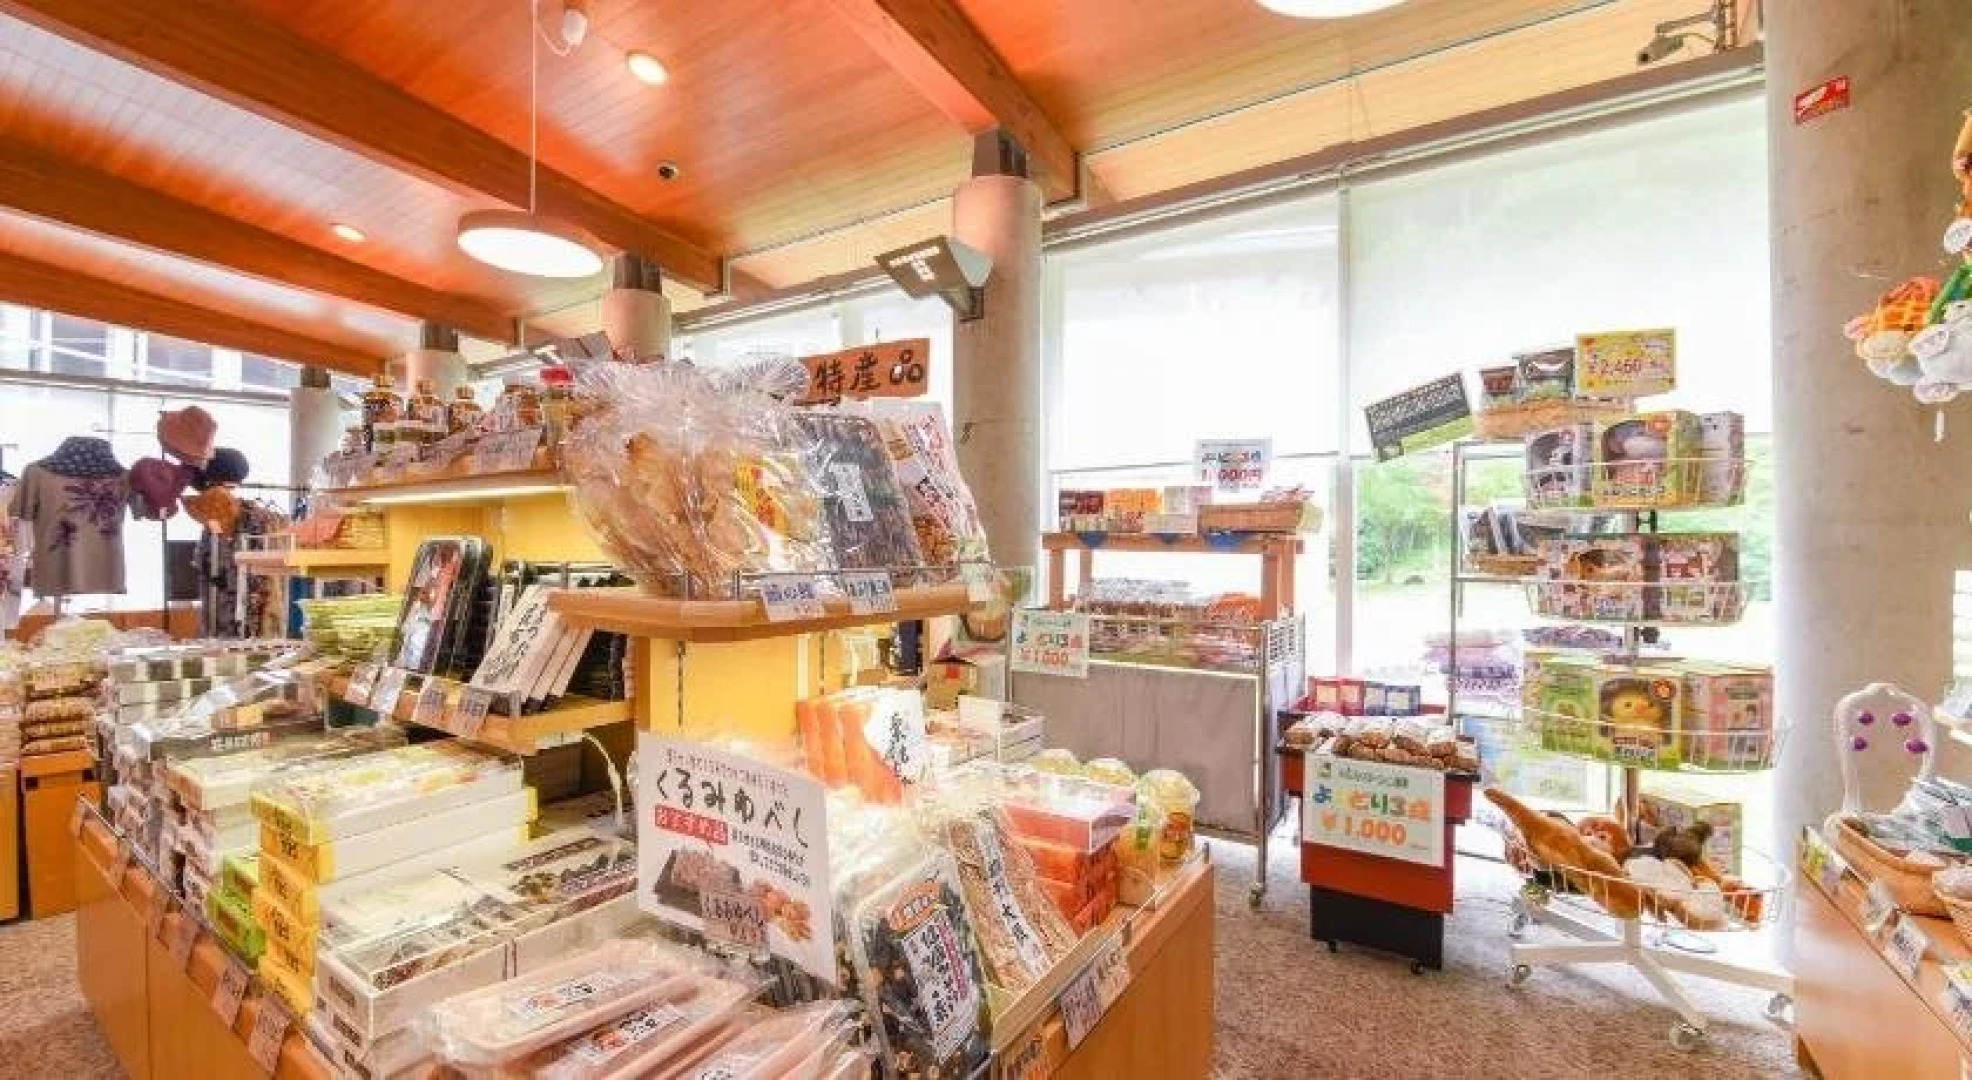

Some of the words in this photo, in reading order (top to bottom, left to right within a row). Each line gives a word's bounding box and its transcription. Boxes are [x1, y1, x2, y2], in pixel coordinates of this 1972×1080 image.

[814, 348, 923, 398] 特産品
[656, 767, 808, 848] くるみゆべし
